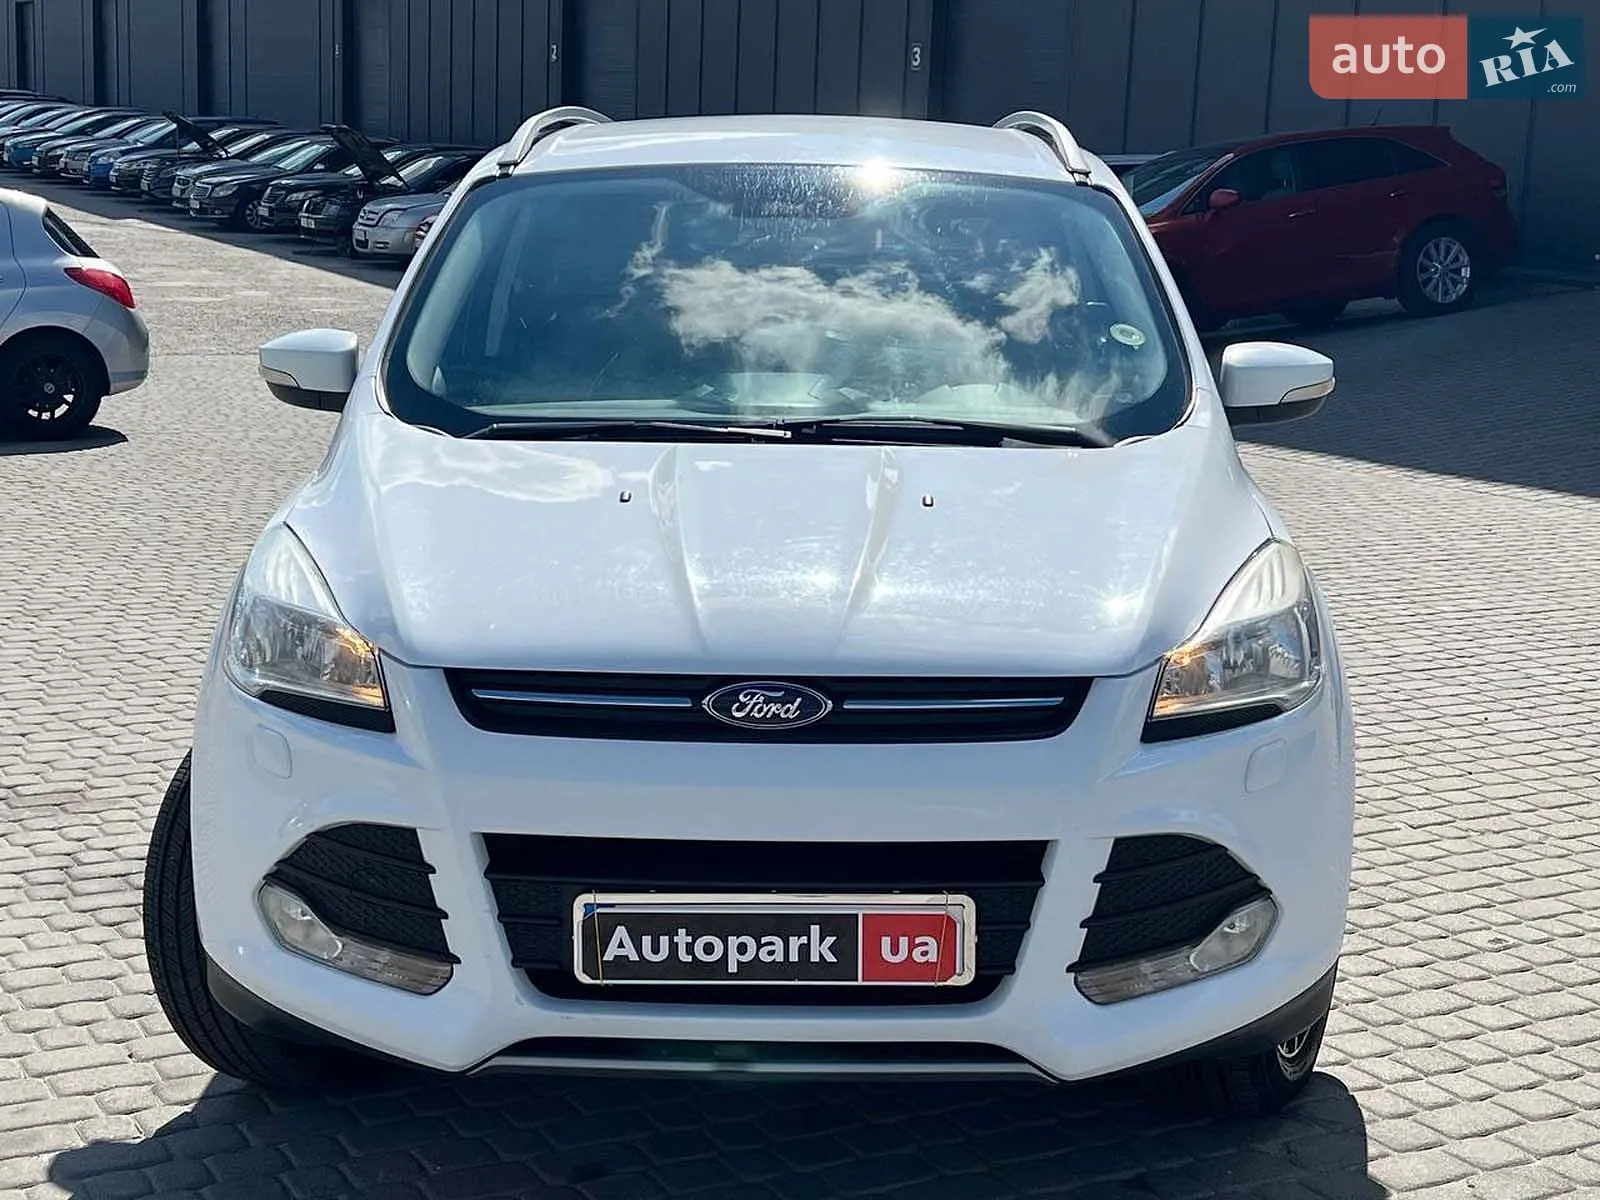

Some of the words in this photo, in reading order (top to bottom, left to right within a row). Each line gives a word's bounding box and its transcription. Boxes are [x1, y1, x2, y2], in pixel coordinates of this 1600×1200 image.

[912, 47, 920, 66] 3
[731, 689, 802, 719] Ford
[602, 925, 838, 973] Autopark
[880, 934, 938, 963] ua
